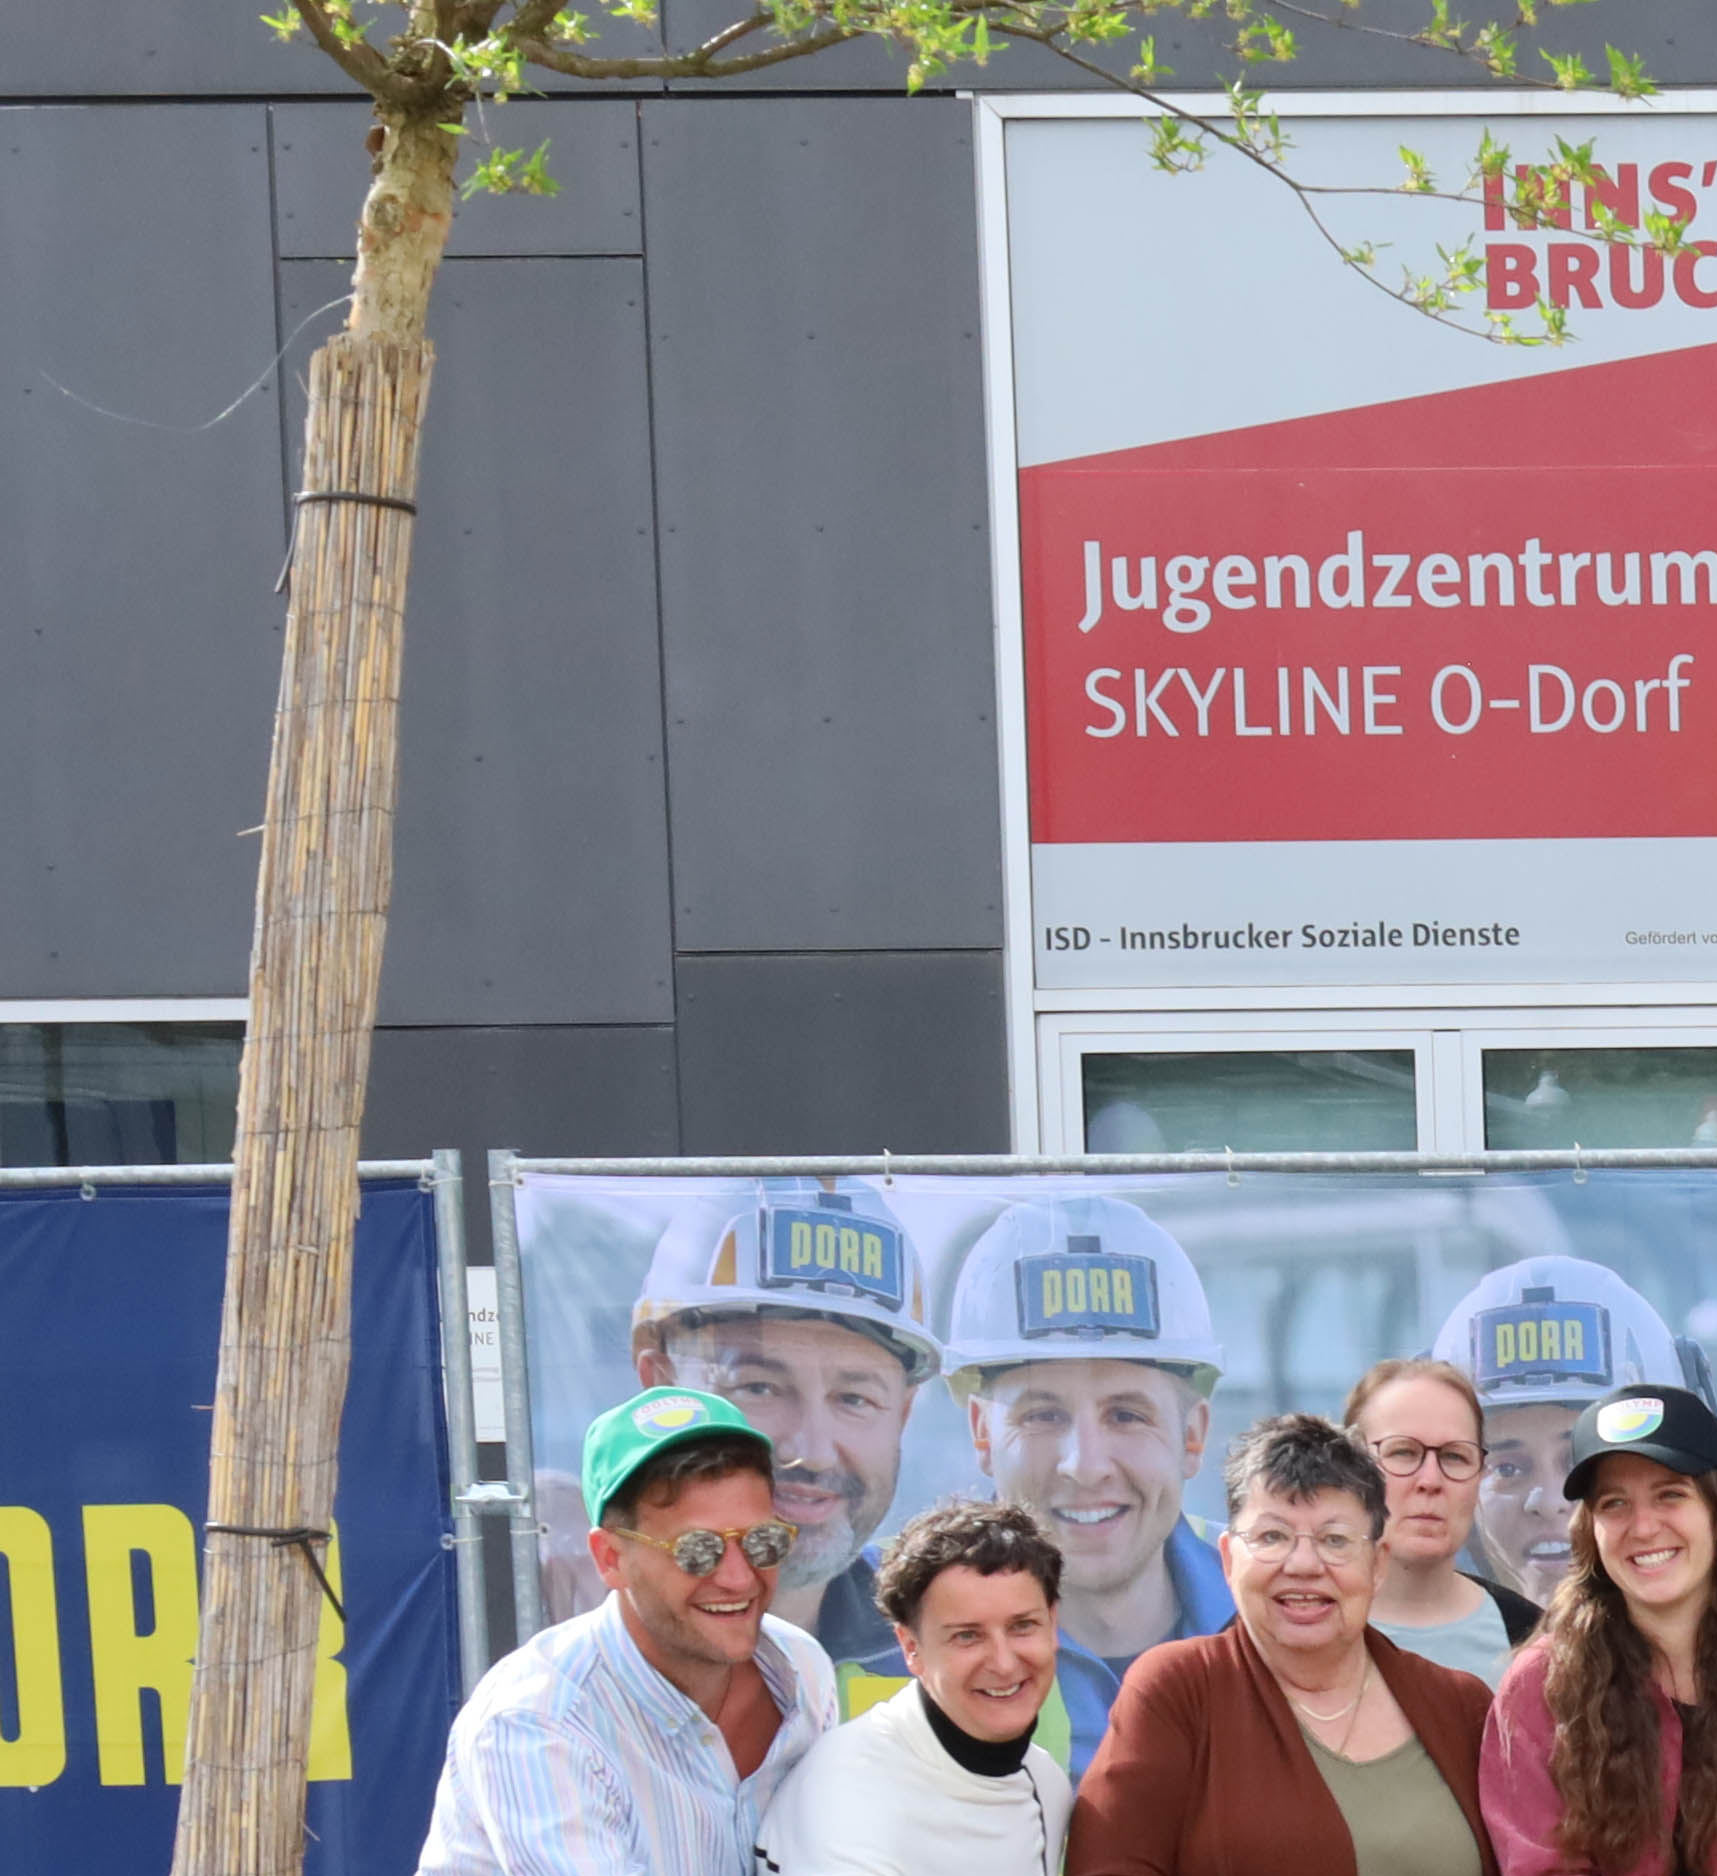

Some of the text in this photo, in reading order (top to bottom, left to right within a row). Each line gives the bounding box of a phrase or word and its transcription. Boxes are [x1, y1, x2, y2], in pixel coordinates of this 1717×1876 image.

[1083, 655, 1695, 739] SKYLINE O-Dorf
[1044, 925, 1091, 951] ISD
[1119, 922, 1293, 950] Innsbrucker
[1301, 921, 1403, 948] Soziale
[1411, 921, 1521, 947] Dienste
[1624, 930, 1698, 945] Gefördert
